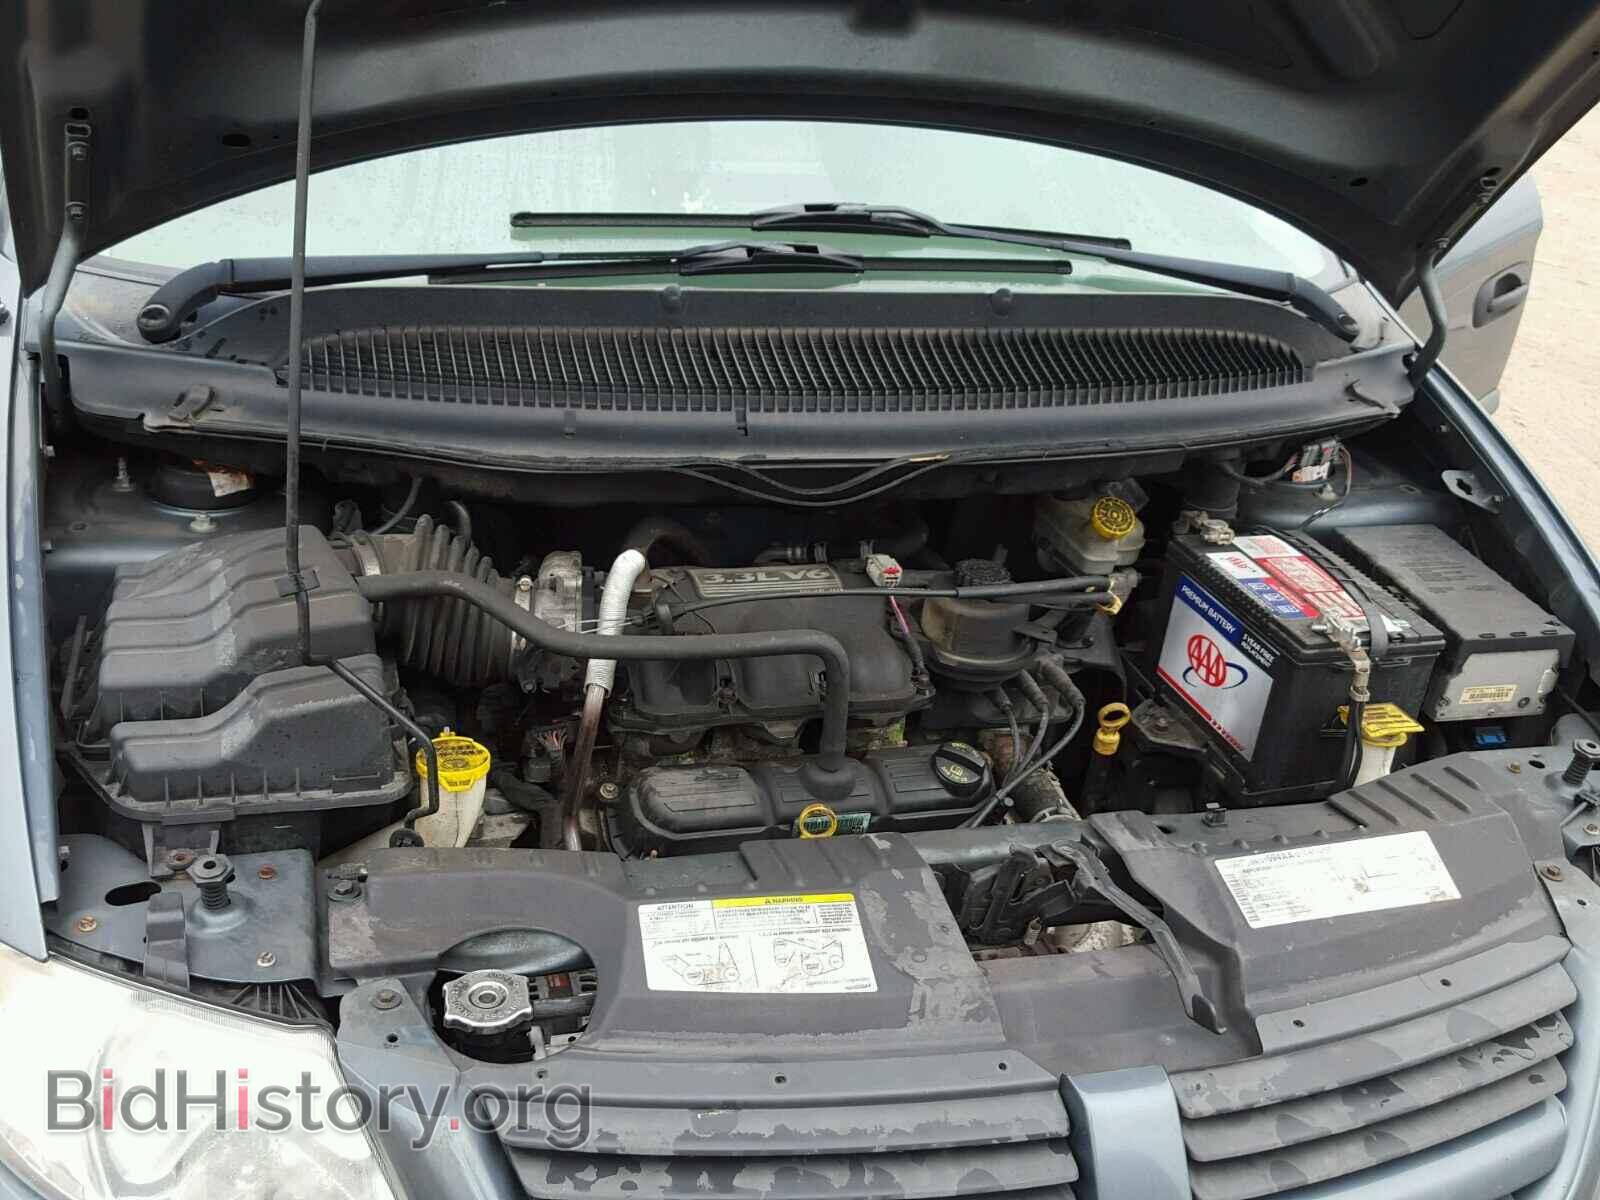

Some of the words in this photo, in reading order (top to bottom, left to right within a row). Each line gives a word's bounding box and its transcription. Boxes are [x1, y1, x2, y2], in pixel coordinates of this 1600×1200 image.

[703, 571, 780, 585] 3.3L
[783, 569, 831, 582] V6
[1207, 607, 1237, 634] BATTERY
[1246, 637, 1261, 652] YEAR
[1188, 636, 1225, 686] AAA
[657, 903, 694, 911] ATTENTION
